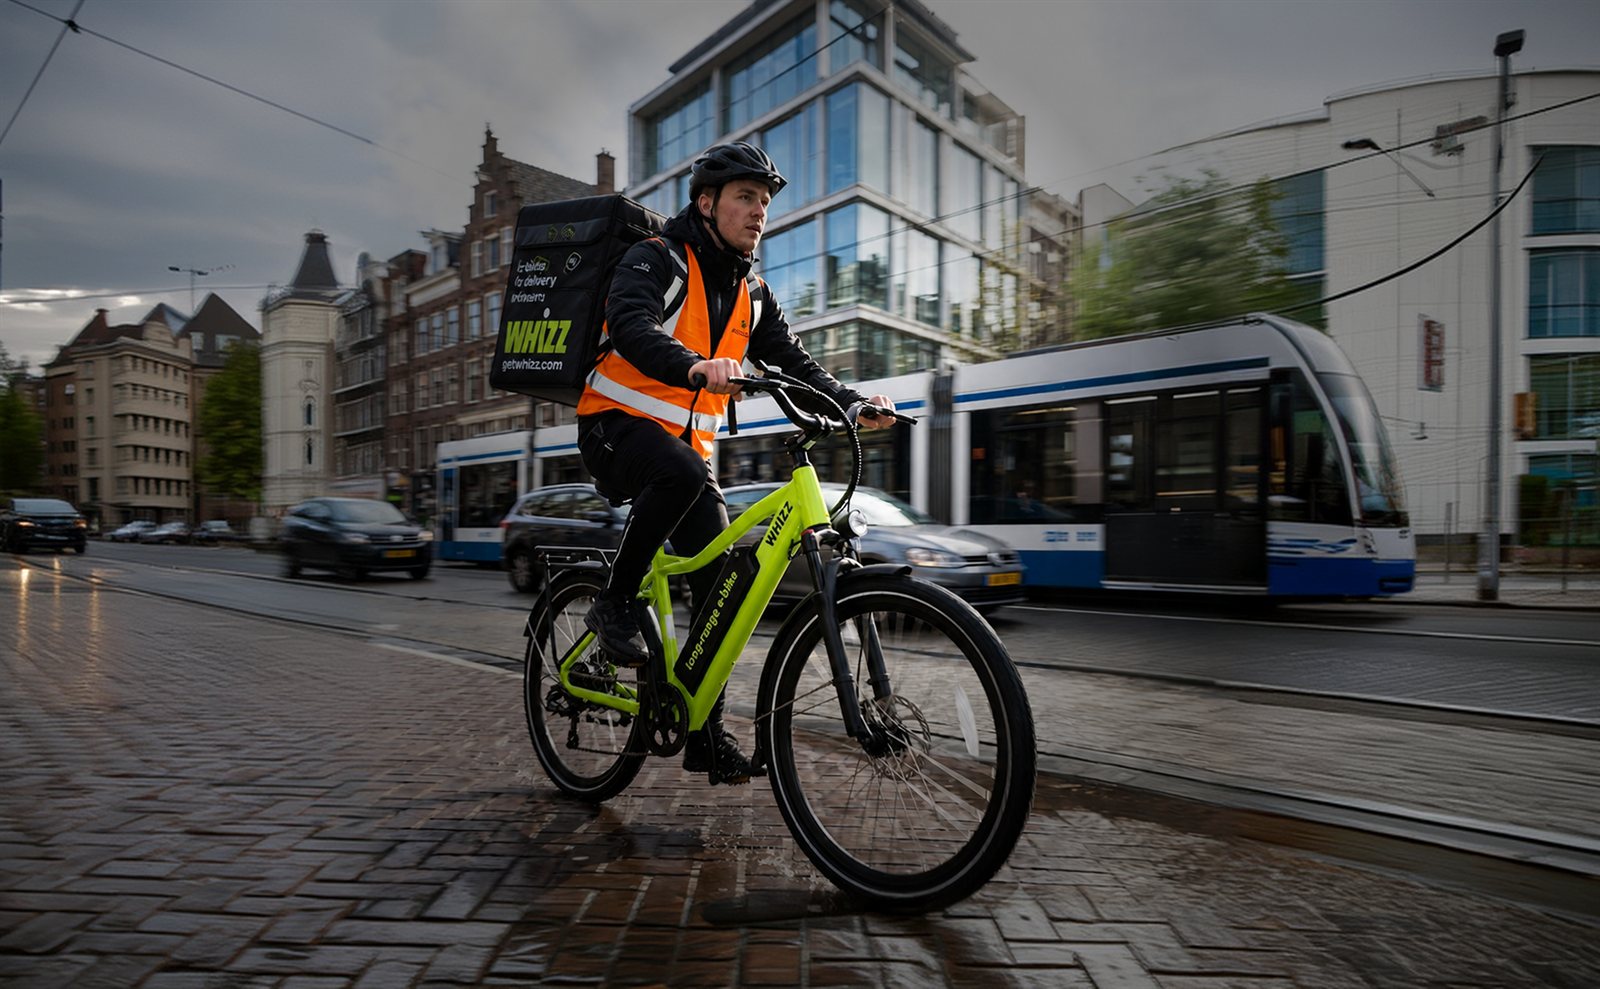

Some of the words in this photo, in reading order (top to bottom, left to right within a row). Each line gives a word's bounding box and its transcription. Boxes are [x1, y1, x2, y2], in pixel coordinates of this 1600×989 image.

[504, 319, 572, 354] WHIZZ
[501, 358, 563, 372] getwhizz.com
[765, 500, 794, 547] WHIZZ
